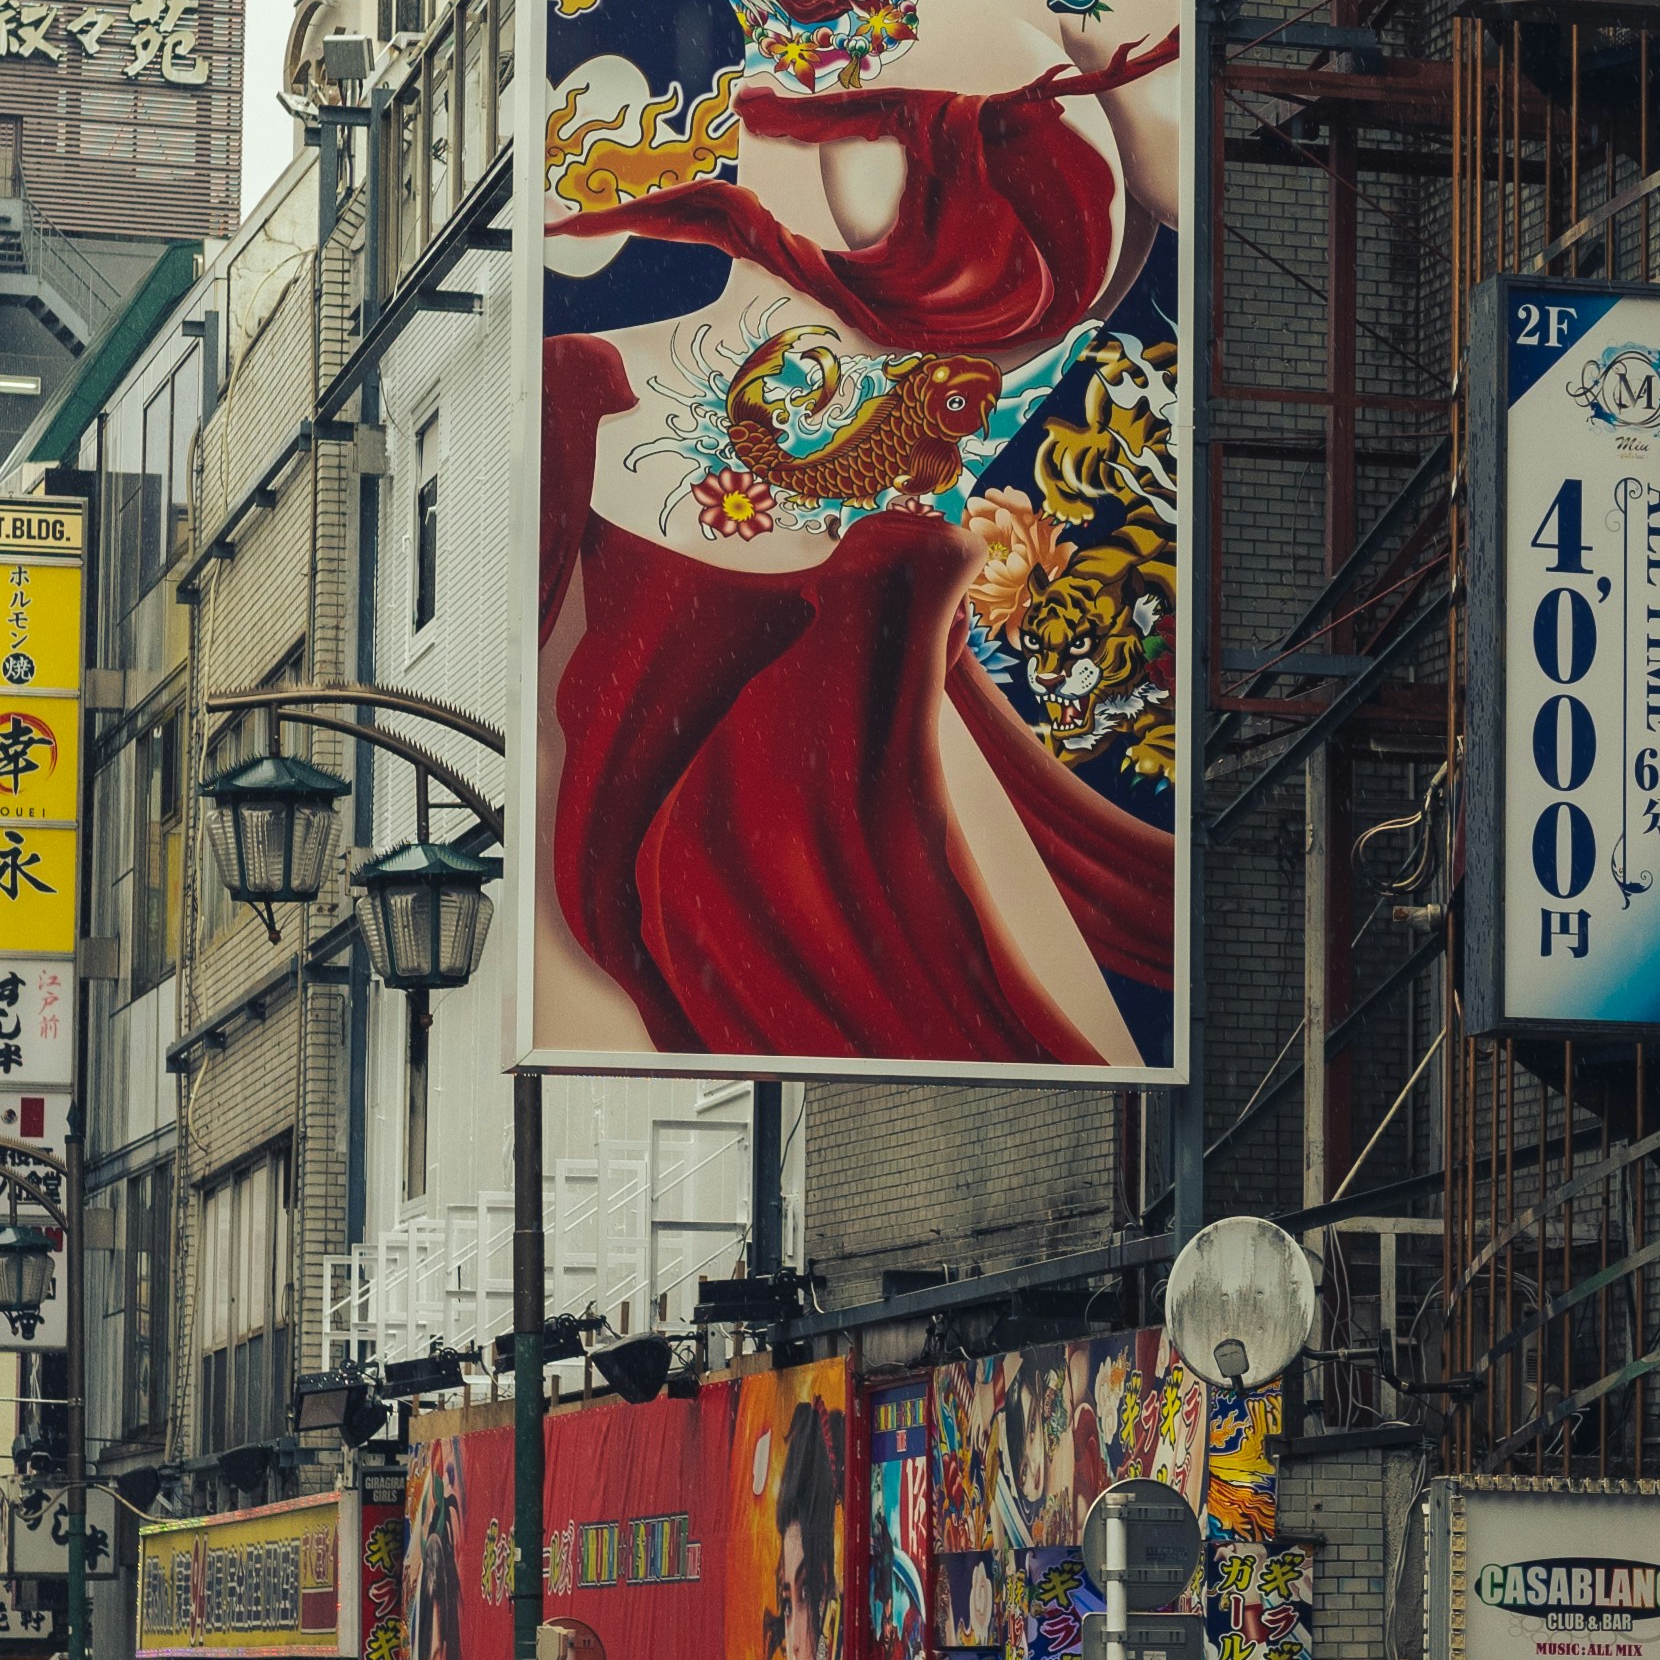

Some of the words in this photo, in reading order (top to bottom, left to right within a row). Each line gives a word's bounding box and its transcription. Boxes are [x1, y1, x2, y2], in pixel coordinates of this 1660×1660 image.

[1516, 303, 1578, 348] 2F
[38, 969, 61, 1039] 江戸前
[373, 1490, 398, 1503] GIRLS
[1547, 1612, 1584, 1631] CLUB
[1586, 1613, 1600, 1631] &
[1601, 1612, 1633, 1631] BAR
[1615, 1643, 1643, 1657] MIX
